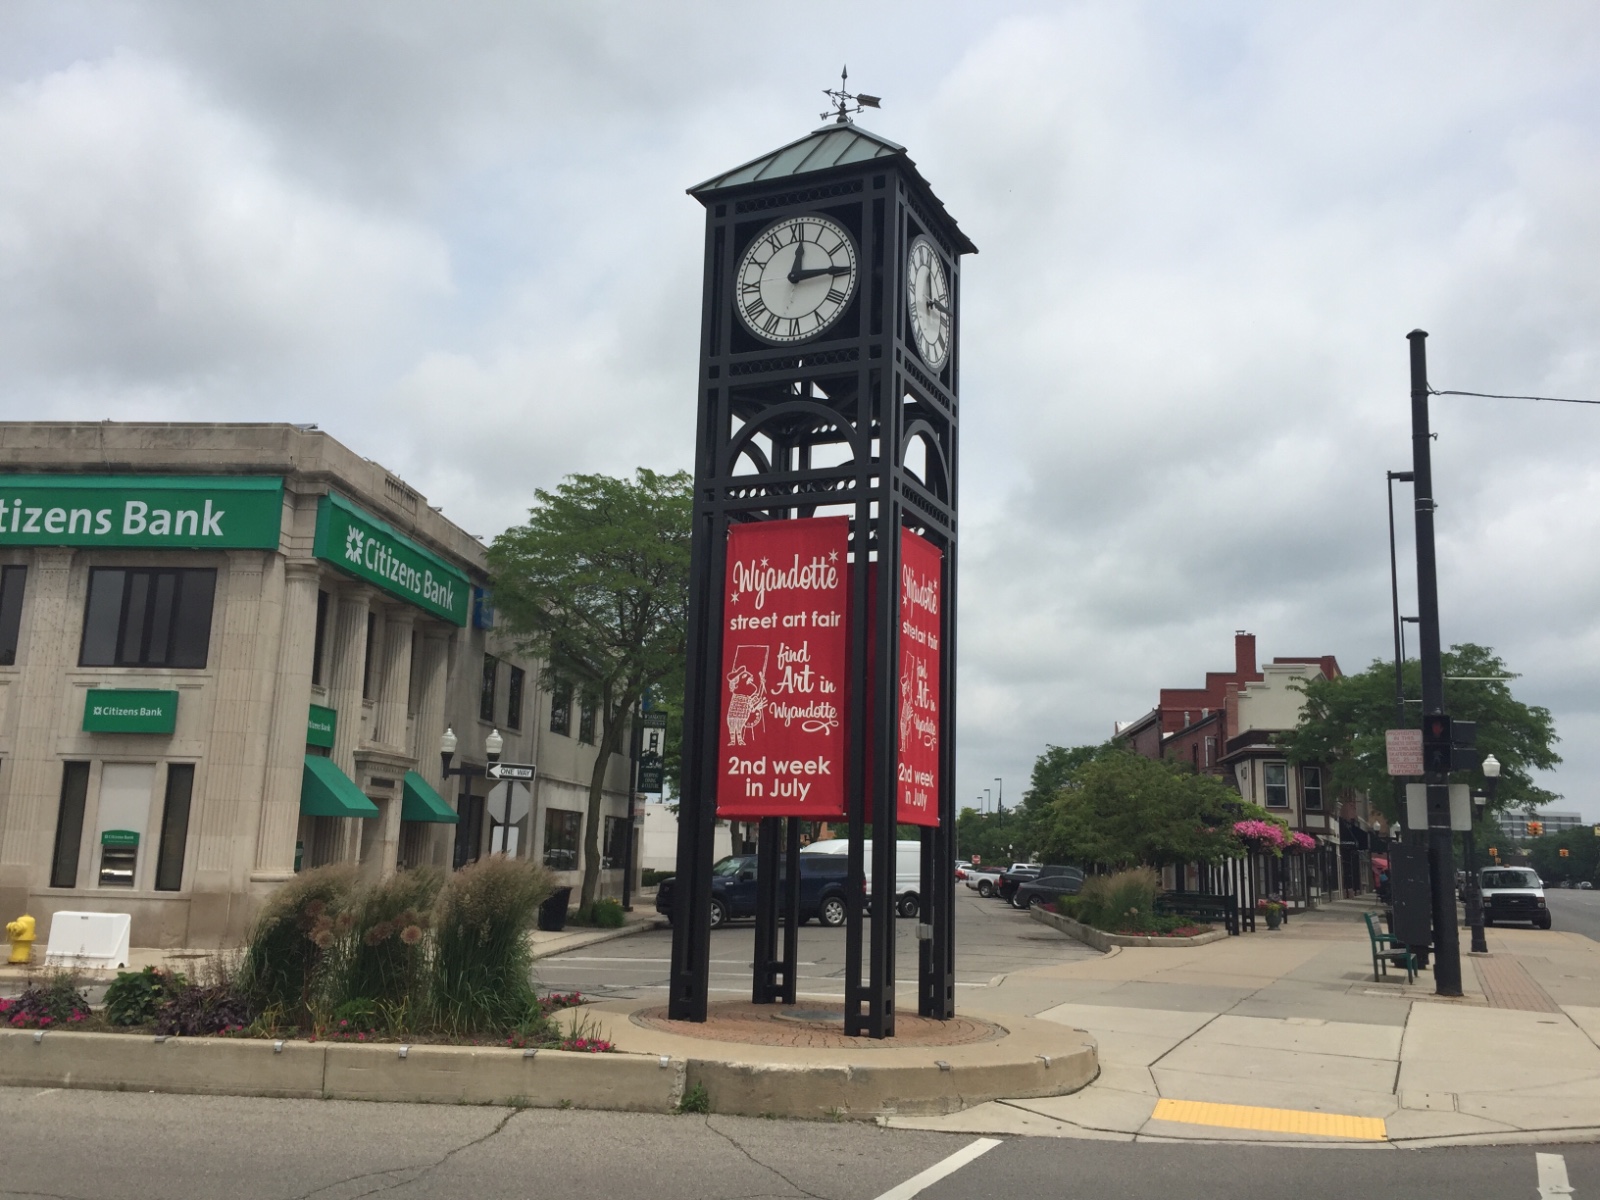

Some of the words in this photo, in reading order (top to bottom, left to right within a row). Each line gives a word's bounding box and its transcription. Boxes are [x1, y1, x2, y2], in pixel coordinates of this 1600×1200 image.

[0, 498, 112, 535] tizens
[122, 499, 225, 536] Bank
[365, 538, 421, 594] Citizens
[423, 569, 454, 611] Bank
[733, 554, 838, 610] Wyandotte
[730, 613, 778, 631] street
[782, 611, 807, 627] art
[811, 610, 841, 627] fair
[777, 640, 810, 670] find
[771, 665, 815, 694] Art
[820, 676, 836, 693] in
[914, 680, 930, 709] At
[103, 706, 138, 716] Citizens
[140, 707, 162, 716] Bank
[769, 701, 838, 728] Wyandotte
[728, 756, 766, 775] 2nd
[773, 756, 831, 775] week
[745, 778, 764, 797] in
[769, 777, 811, 801] July
[914, 771, 935, 788] week
[905, 787, 911, 805] in
[913, 788, 928, 811] July
